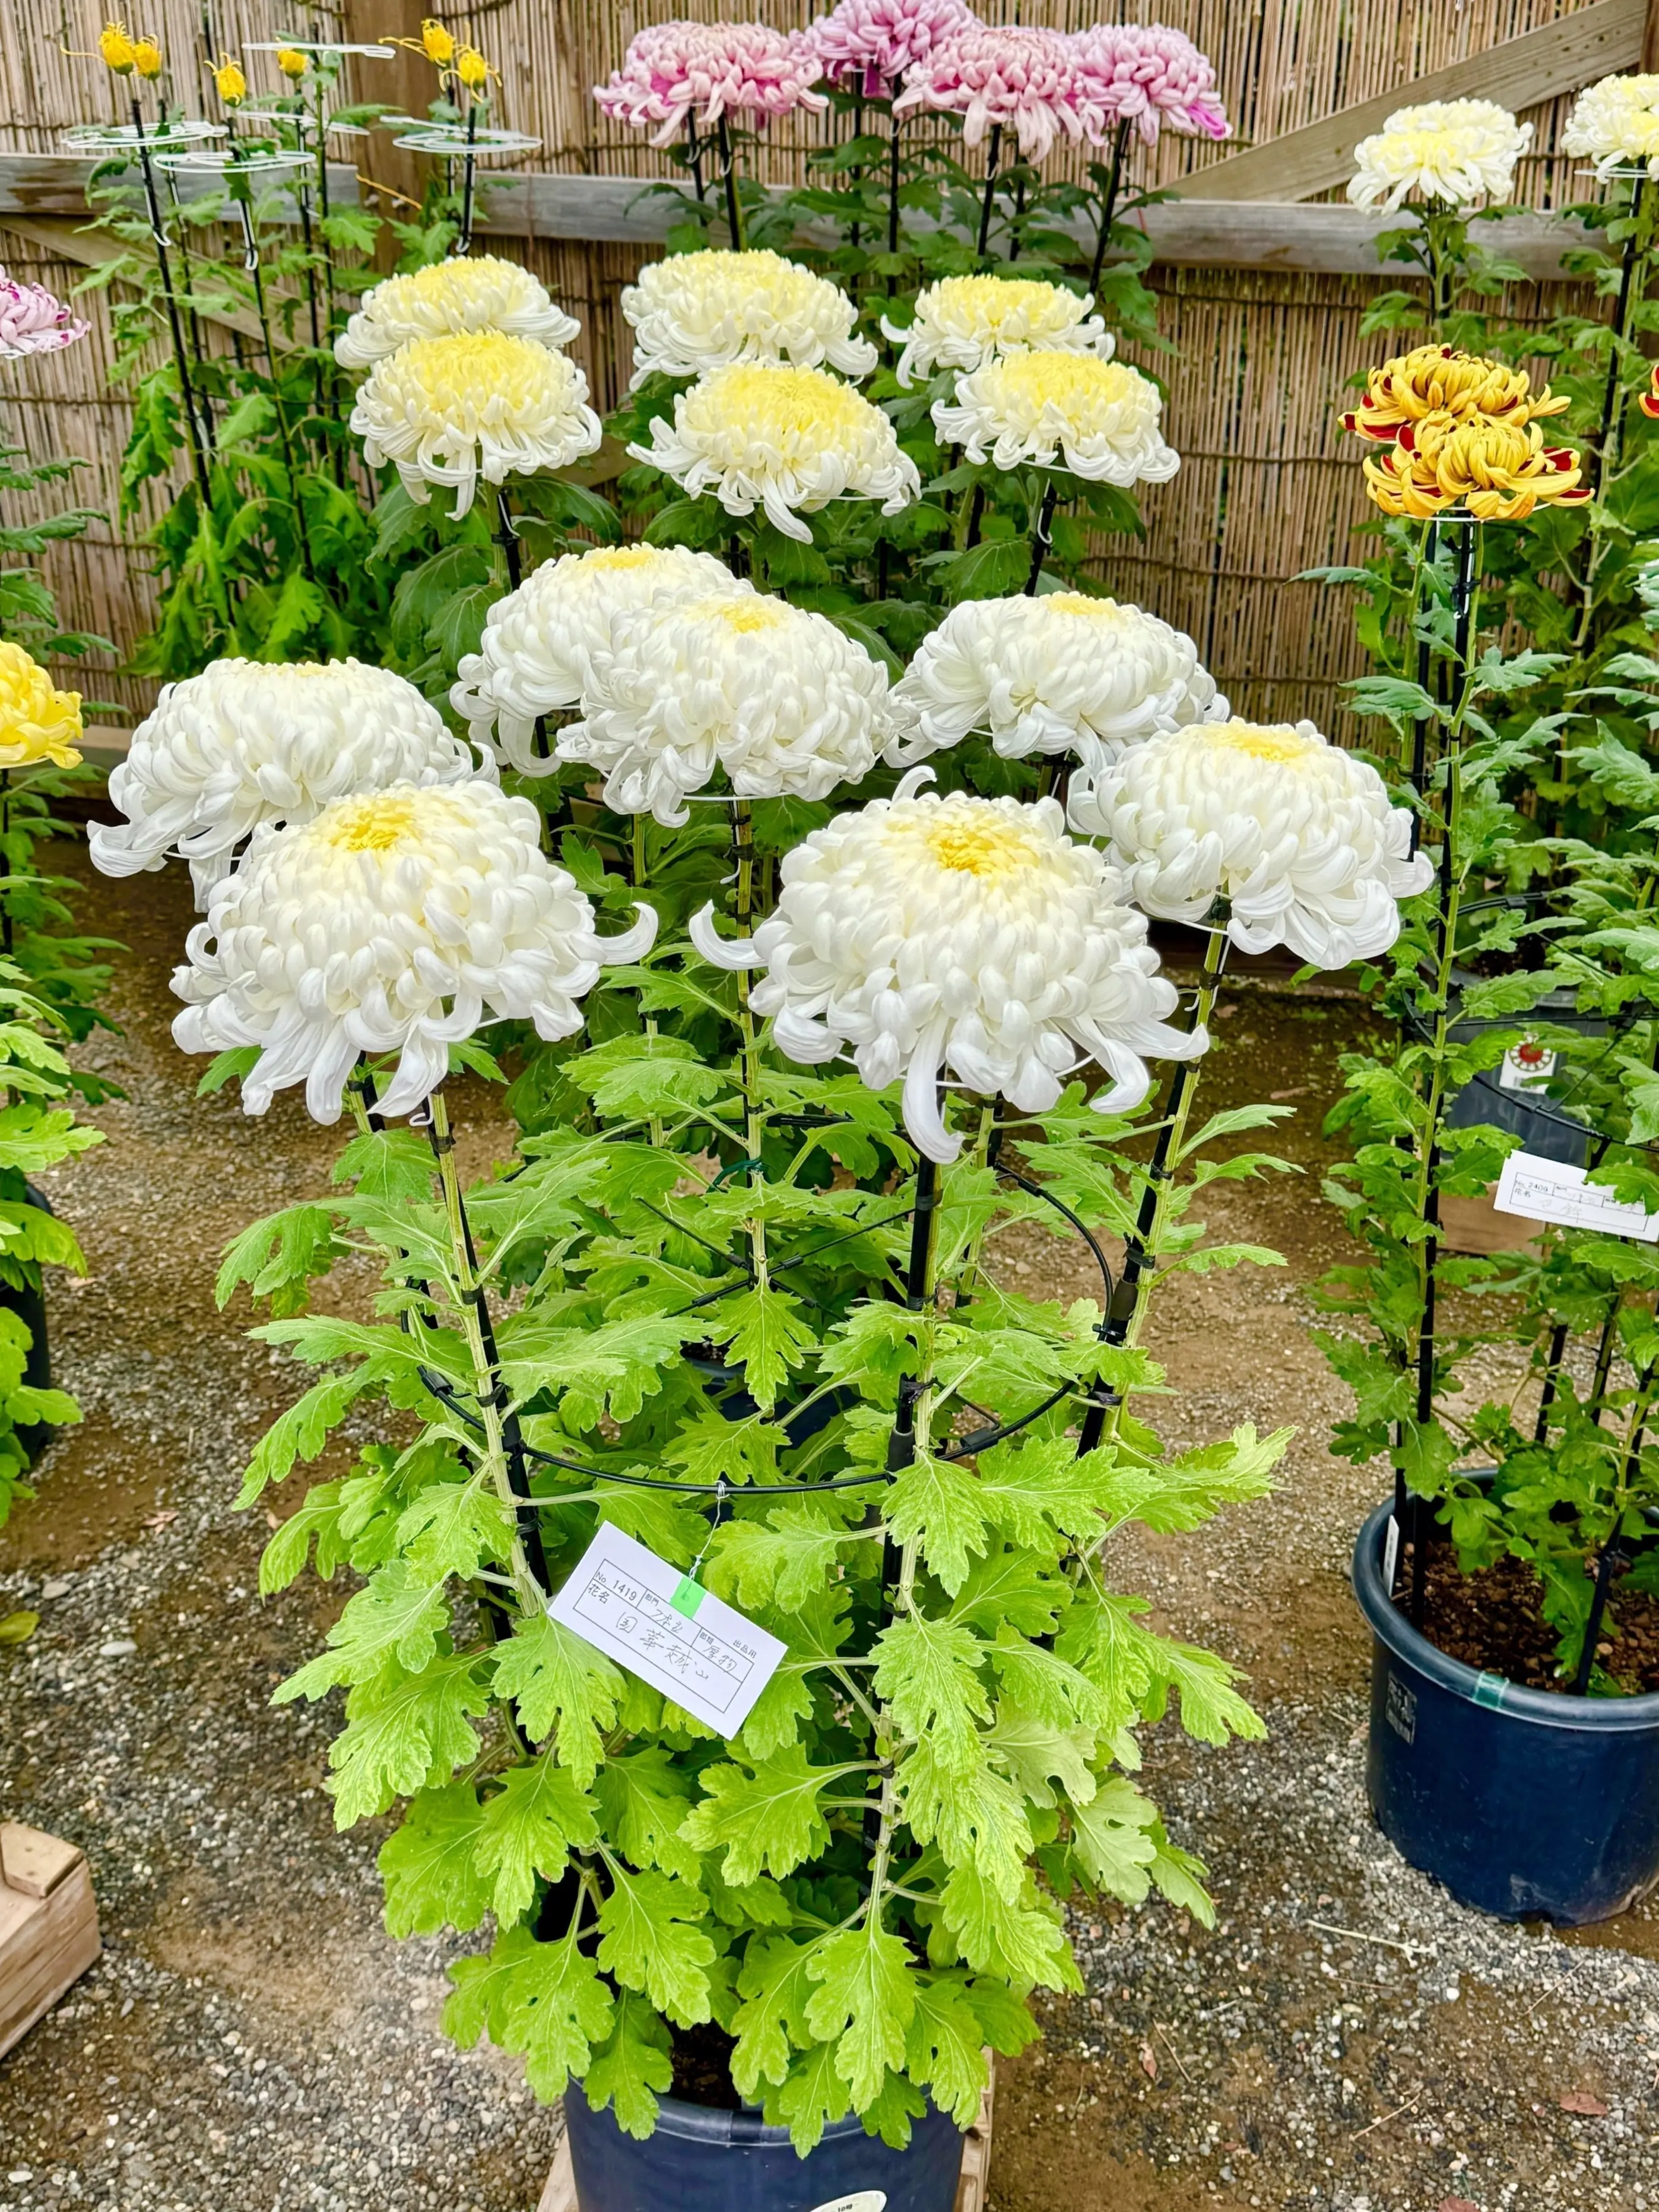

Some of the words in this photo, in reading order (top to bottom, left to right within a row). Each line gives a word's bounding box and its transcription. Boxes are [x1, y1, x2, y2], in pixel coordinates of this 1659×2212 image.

[588, 1583, 608, 1604] 花名
[596, 1570, 607, 1584] No.
[612, 1579, 637, 1601] 1419
[733, 1639, 757, 1658] 出品用
